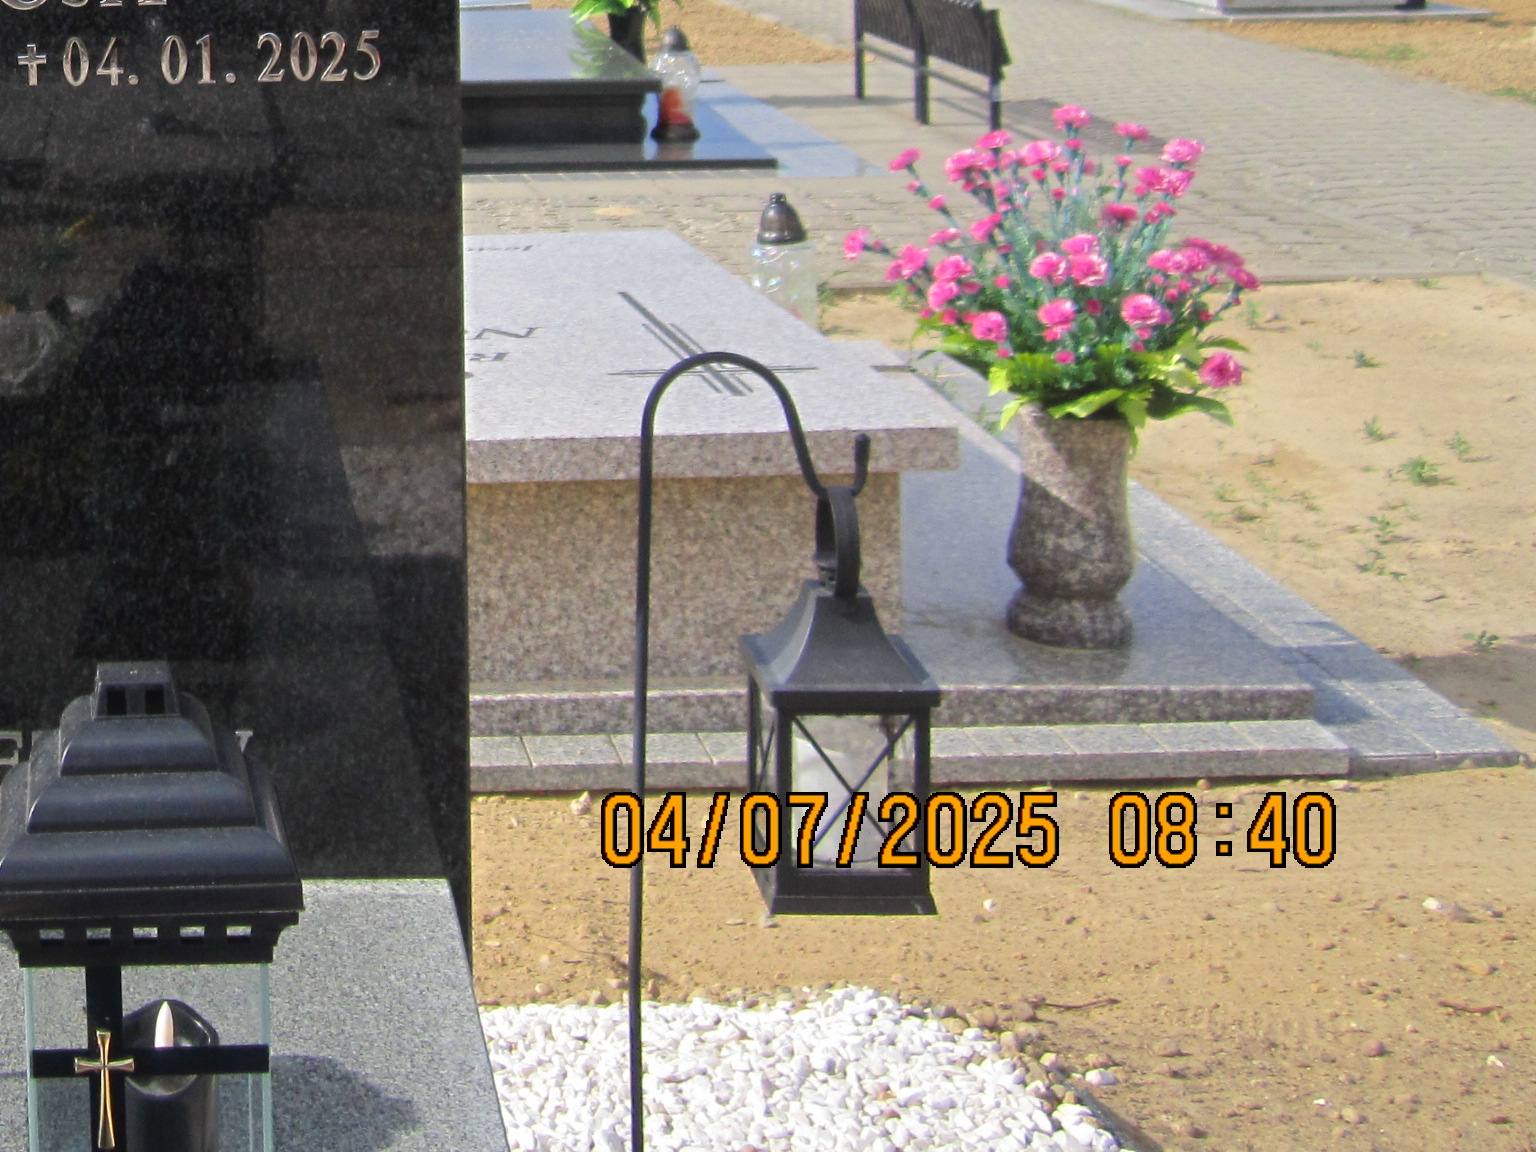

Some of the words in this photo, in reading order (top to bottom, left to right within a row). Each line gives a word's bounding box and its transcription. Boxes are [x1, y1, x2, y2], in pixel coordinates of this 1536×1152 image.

[63, 36, 139, 88] 04.
[160, 34, 237, 86] 01.
[256, 29, 382, 83] 2025
